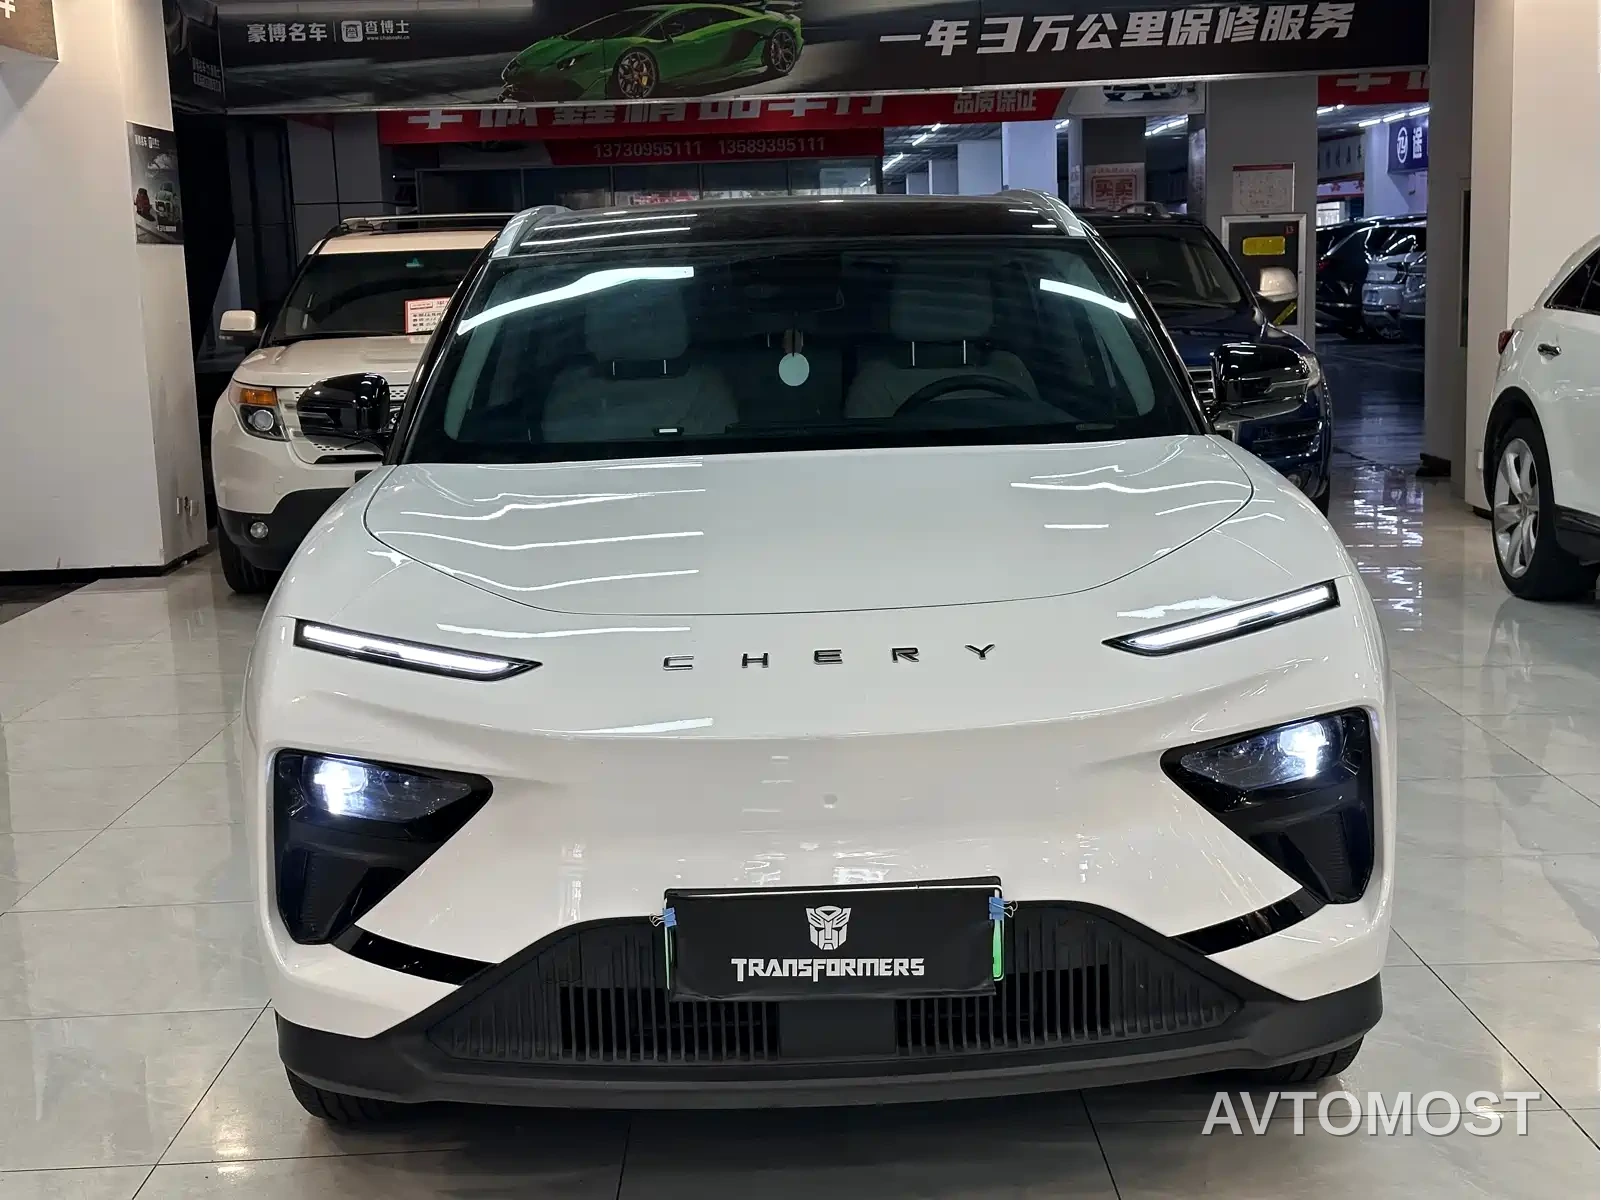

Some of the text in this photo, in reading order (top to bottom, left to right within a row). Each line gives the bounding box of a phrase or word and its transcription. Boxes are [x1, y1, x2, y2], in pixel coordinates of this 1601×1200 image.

[247, 22, 327, 43] 豪博名车
[364, 19, 410, 35] 查博士
[879, 2, 1355, 56] 一年3万公里保修服务
[952, 88, 1038, 114] 品质保证
[593, 139, 704, 159] 13730955111
[663, 642, 996, 671] CHERY
[730, 957, 925, 983] TRANSFORMERS
